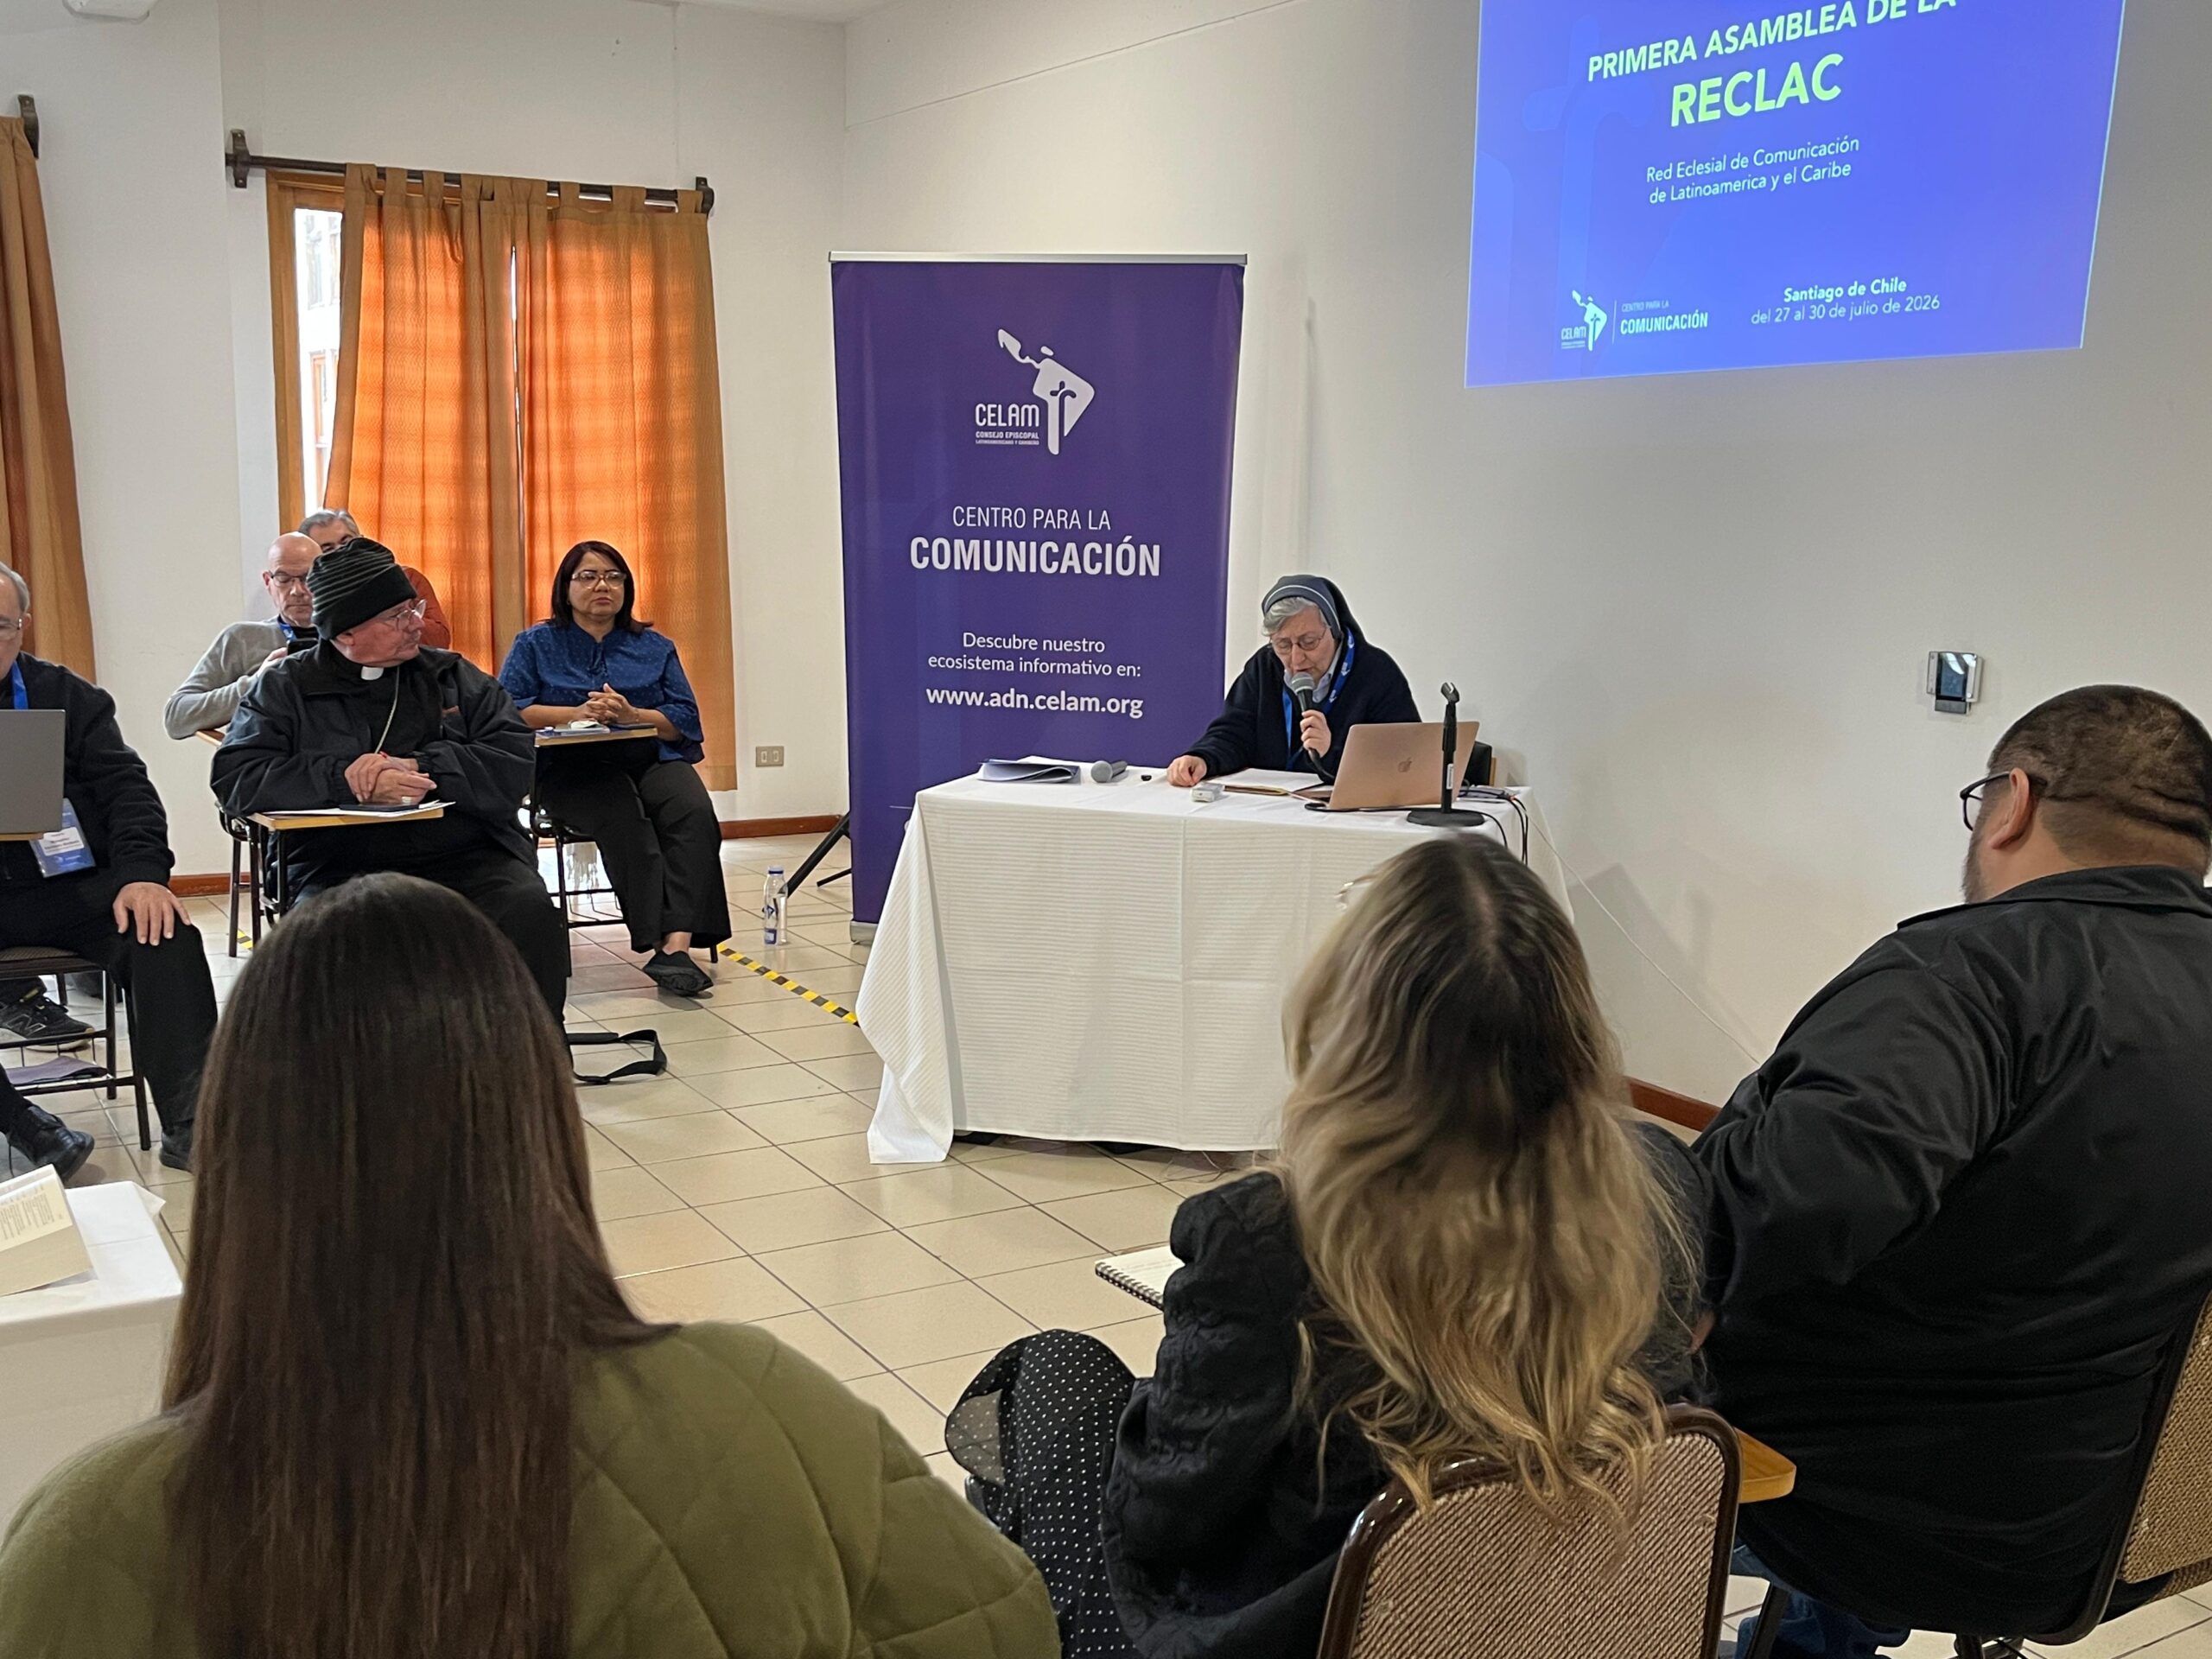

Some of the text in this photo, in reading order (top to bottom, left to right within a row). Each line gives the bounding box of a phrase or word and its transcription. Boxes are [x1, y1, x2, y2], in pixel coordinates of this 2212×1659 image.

[1588, 35, 1697, 81] PRIMERA
[1704, 1, 1858, 59] ASAMBLEA
[1866, 0, 1907, 24] DE
[1670, 53, 1844, 127] RECLAC
[1646, 135, 1860, 183] Red Eclesial de Comunicación
[1649, 160, 1852, 204] de Latinoamerica y el Caribe
[1783, 276, 1908, 302] Santiago de Chile
[1620, 309, 1709, 335] COMUNICACIÓN
[1751, 294, 1941, 325] del 27 al 30 de julio de 2026
[975, 403, 1039, 427] CELAM
[976, 430, 1004, 439] CONSEJO
[952, 505, 1112, 531] CENTRO PARA LA
[910, 535, 1160, 577] COMUNICACIÓN
[963, 632, 1106, 653] Descubre nuestro
[927, 654, 1141, 677] ecosistema informativo en:
[925, 688, 1144, 719] www.adn.celam.org
